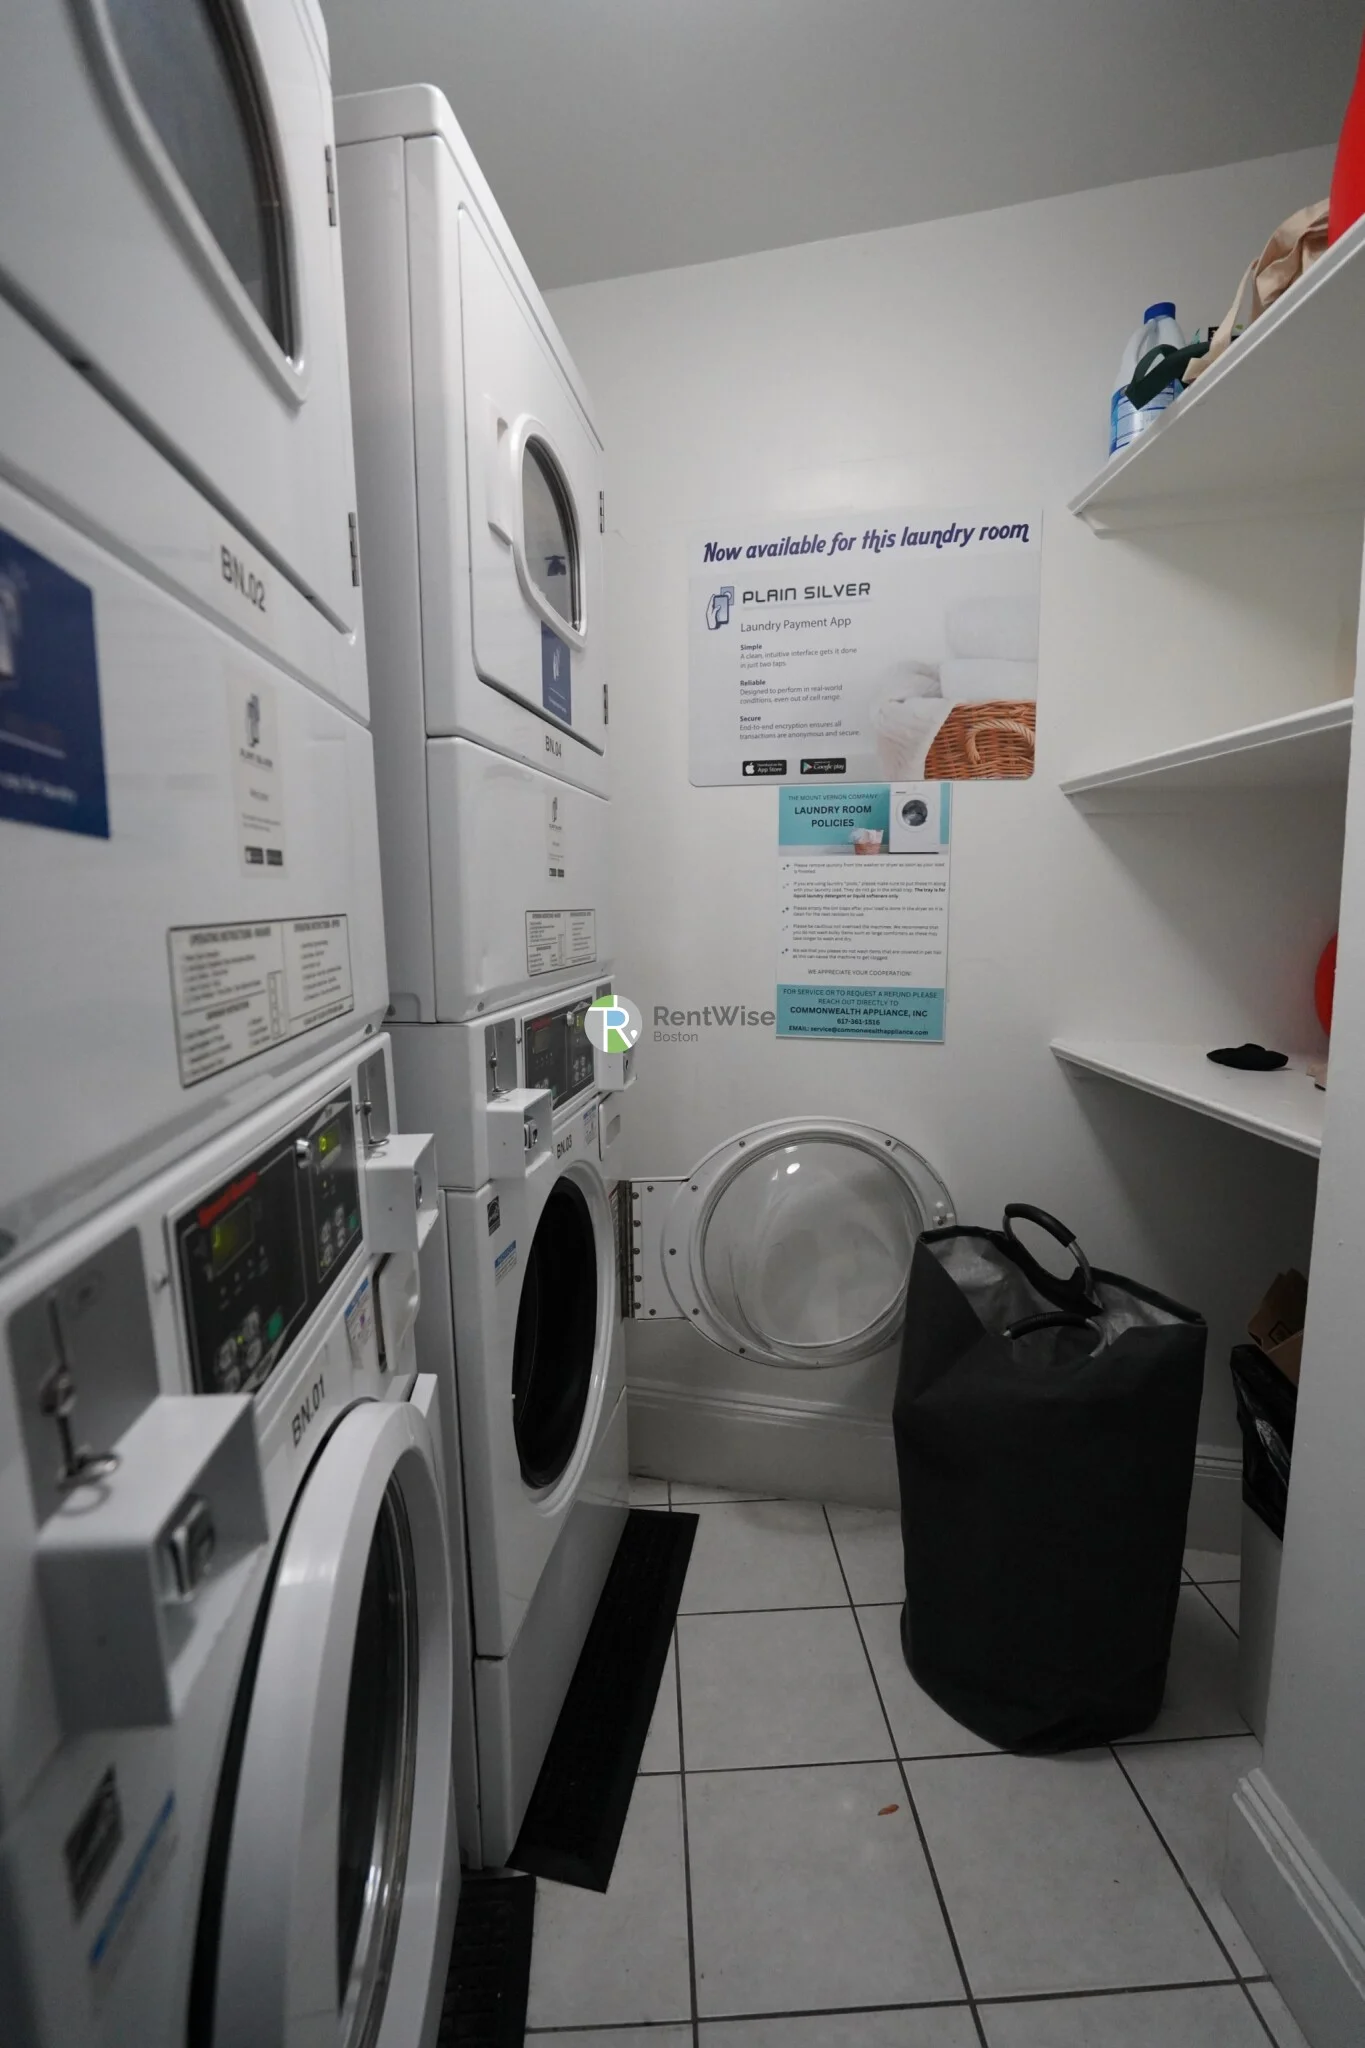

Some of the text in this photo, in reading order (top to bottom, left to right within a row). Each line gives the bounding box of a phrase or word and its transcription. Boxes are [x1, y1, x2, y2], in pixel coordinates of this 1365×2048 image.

[704, 523, 1030, 562] Now available for this laundry room
[220, 544, 266, 612] BN.02
[742, 582, 870, 604] PLAIN SILVER
[740, 617, 852, 632] Laundry Payment App
[740, 644, 762, 652] Simple
[740, 688, 768, 696] Designed
[778, 687, 802, 696] perform
[811, 684, 842, 692] real-world
[775, 723, 808, 732] encryption
[546, 736, 562, 758] BN.04
[794, 806, 872, 814] LAUNDRY ROOM
[812, 819, 854, 828] POLICIES
[790, 1006, 860, 1015] COMMONWEALTH
[863, 1009, 911, 1018] APPLIANCE,
[556, 1134, 572, 1159] BN.03
[292, 1374, 325, 1448] BN.01
